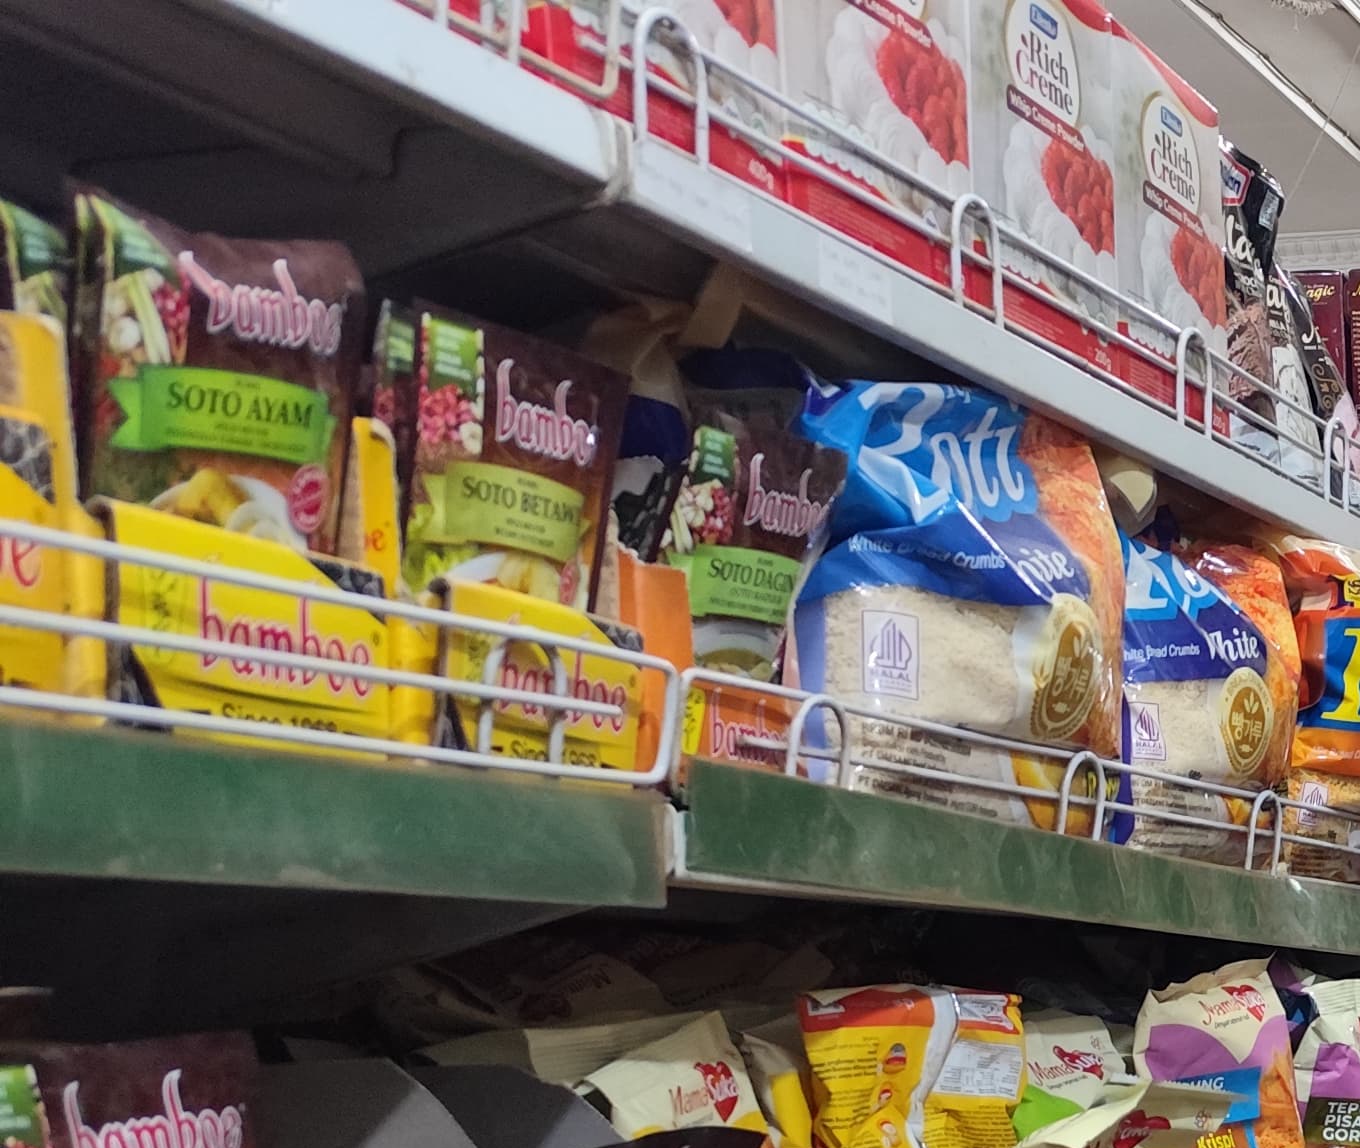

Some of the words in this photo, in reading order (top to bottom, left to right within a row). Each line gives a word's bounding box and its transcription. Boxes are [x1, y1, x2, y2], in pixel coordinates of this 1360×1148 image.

[1015, 48, 1075, 116] Creme
[1027, 31, 1071, 89] Rich
[1149, 147, 1196, 205] Creme
[1160, 130, 1194, 181] Rich
[1305, 283, 1336, 299] agic
[166, 380, 243, 418] SOTO
[241, 394, 315, 429] AYAM
[461, 475, 518, 508] SOTO
[706, 557, 754, 588] SOTO
[753, 565, 798, 594] DAGIN
[952, 548, 1007, 571] Crumbs
[199, 558, 373, 698] bamboe
[1205, 623, 1261, 664] White
